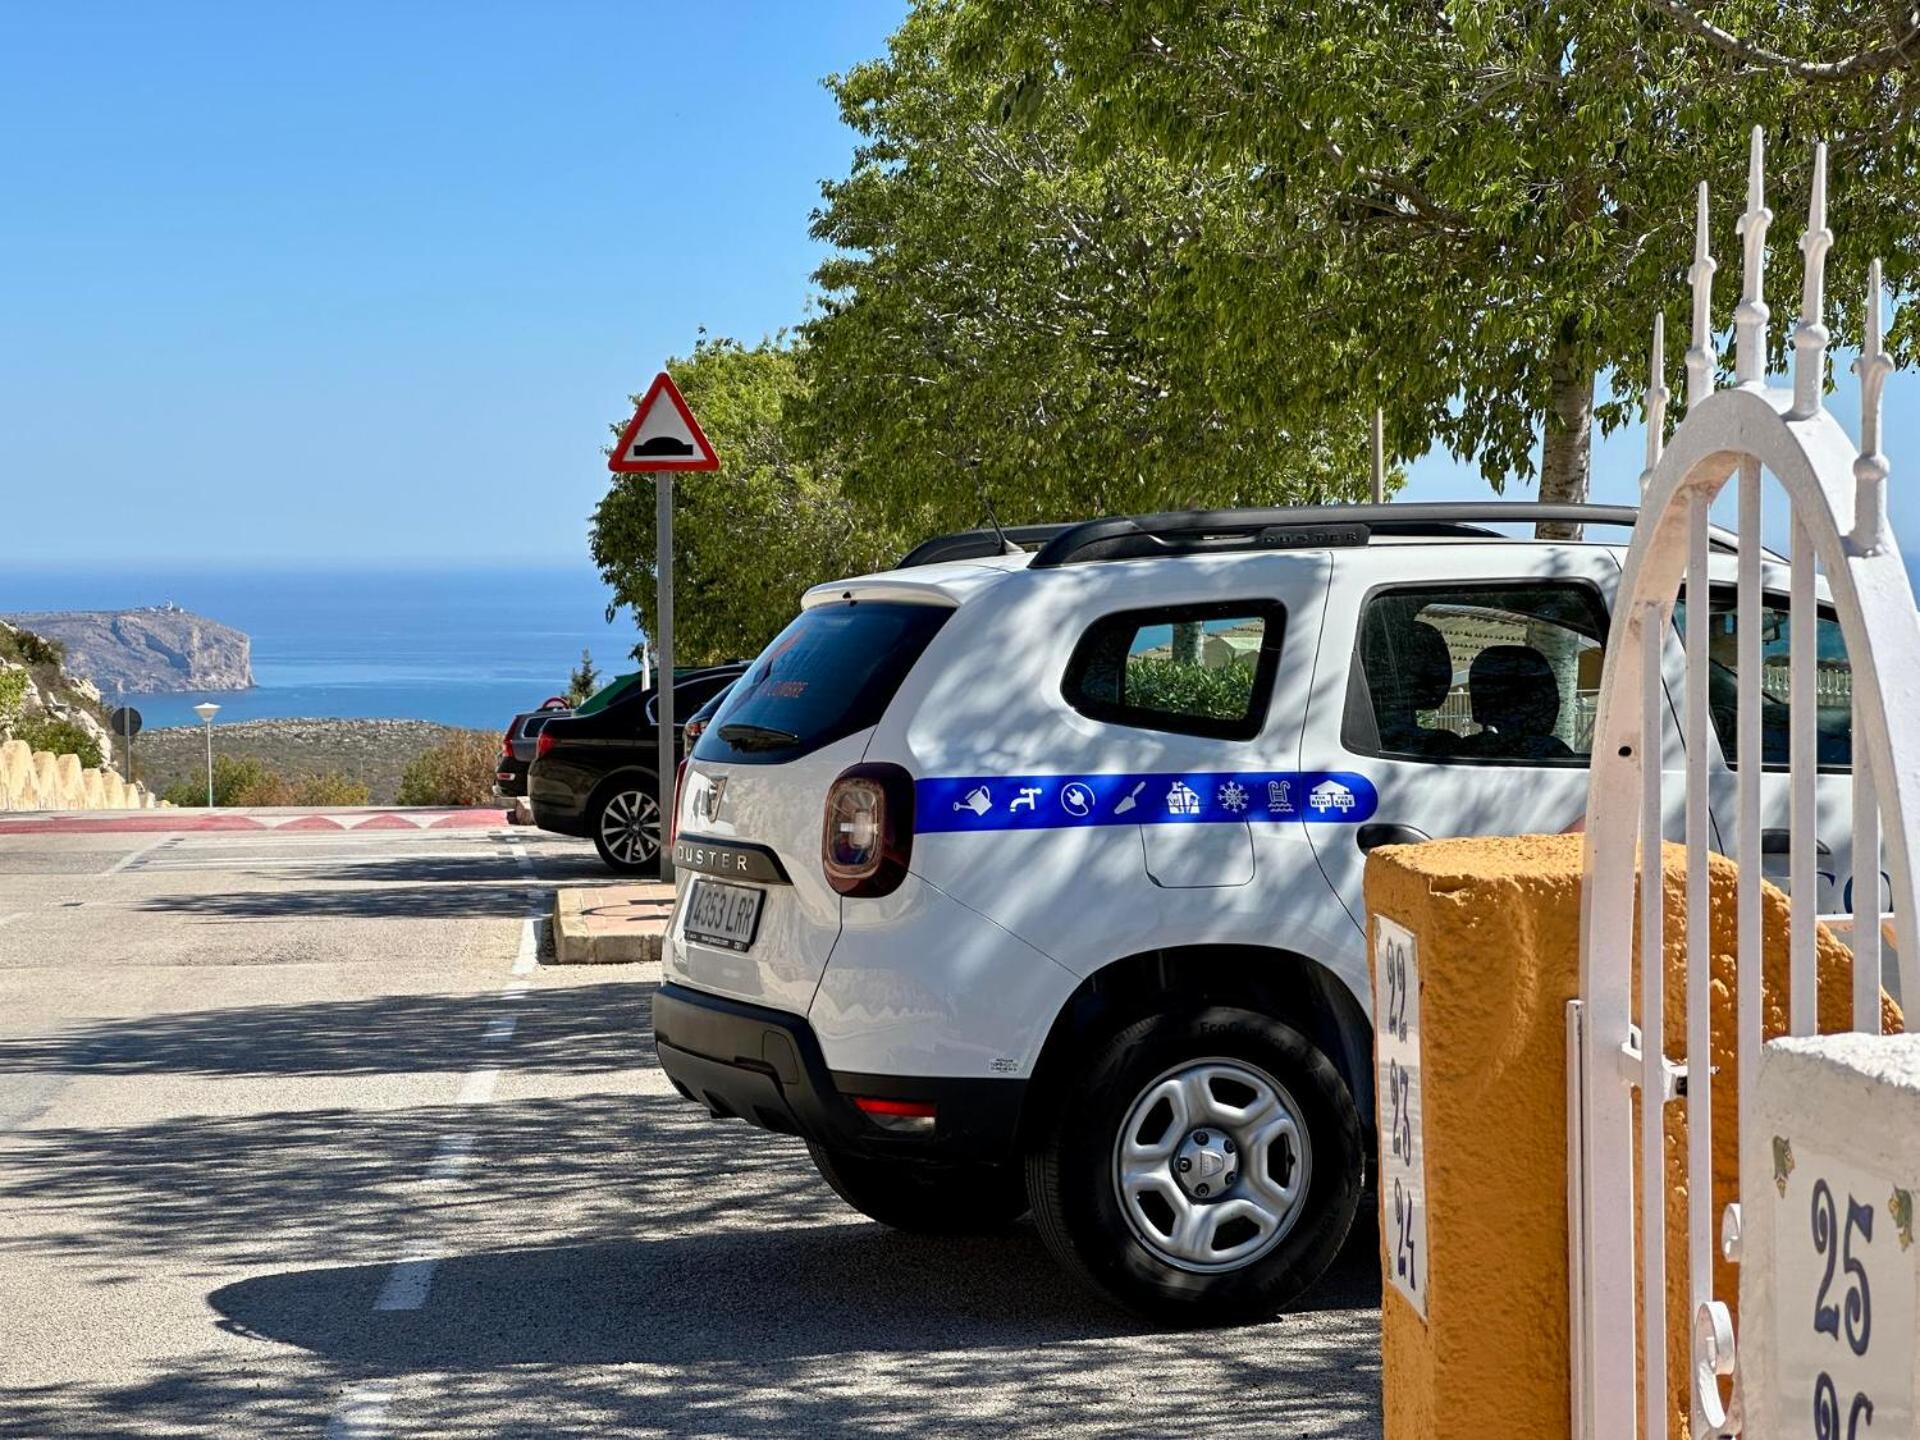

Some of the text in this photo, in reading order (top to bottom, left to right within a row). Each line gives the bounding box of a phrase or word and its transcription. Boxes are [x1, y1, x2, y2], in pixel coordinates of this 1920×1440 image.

[678, 845, 748, 871] DUSTER
[693, 889, 755, 935] 4353 LRR
[1386, 936, 1408, 1045] 22
[1389, 1057, 1411, 1168] 23
[1393, 1174, 1416, 1292] 24
[1811, 1177, 1874, 1356] 25
